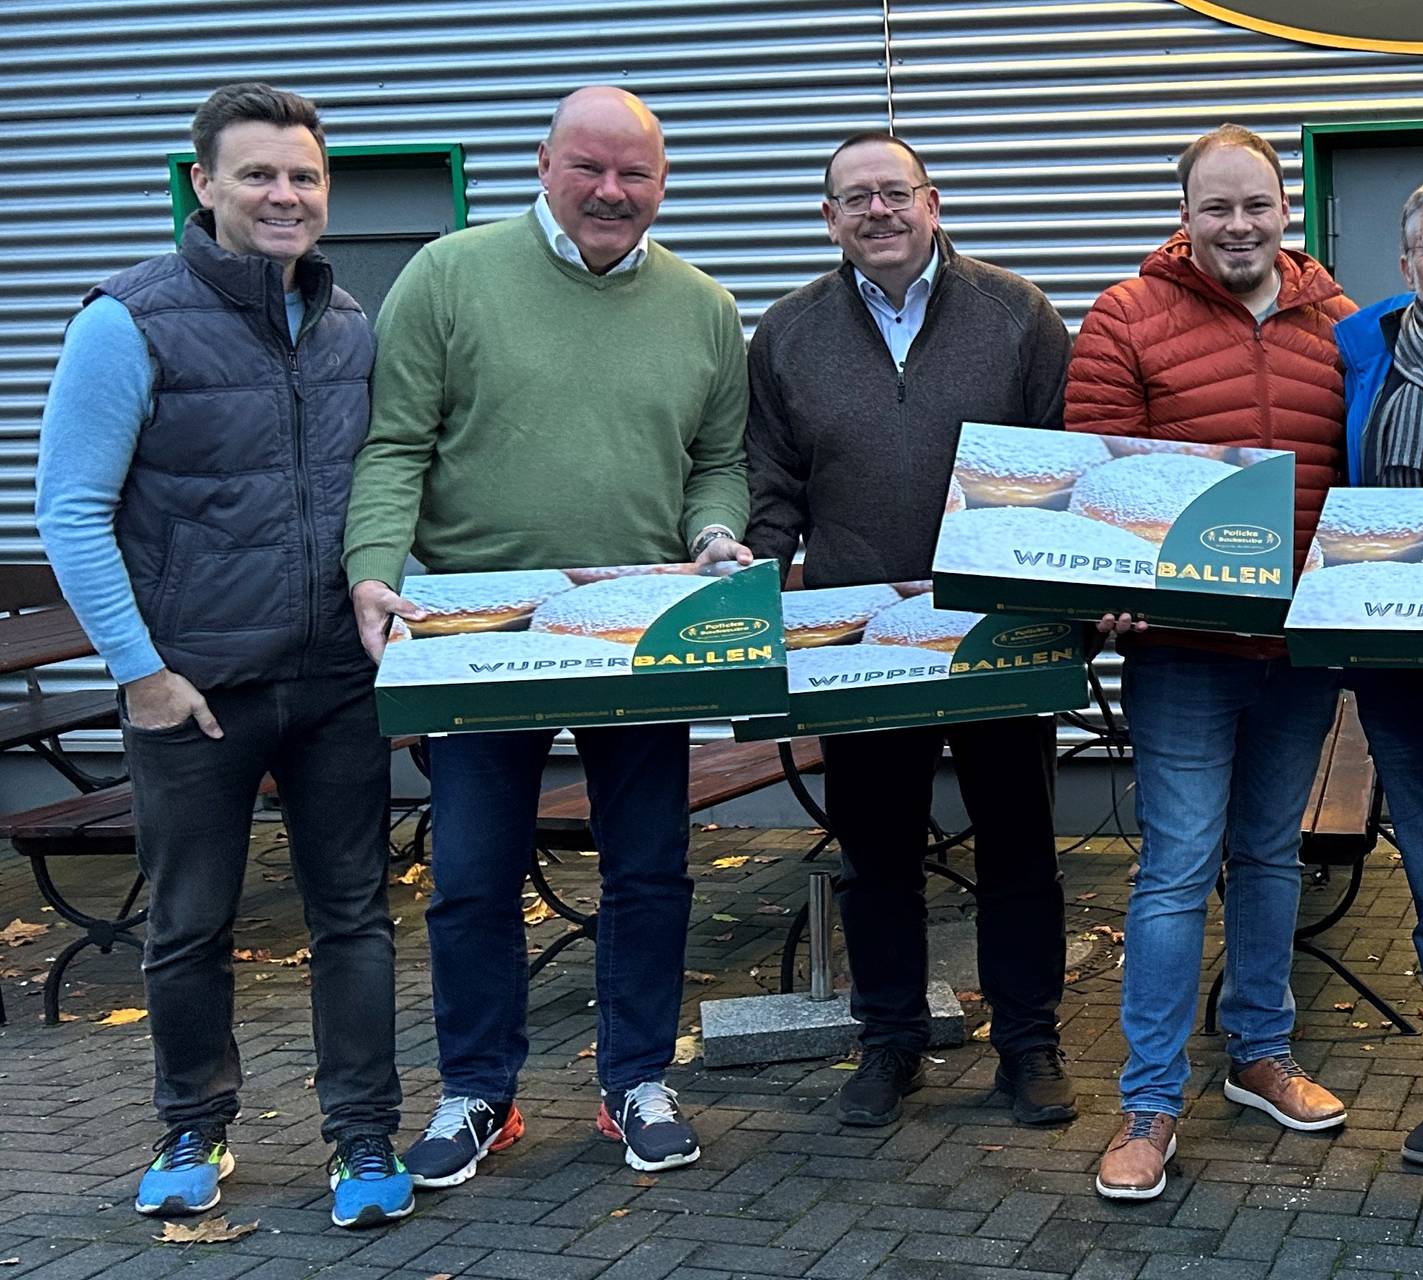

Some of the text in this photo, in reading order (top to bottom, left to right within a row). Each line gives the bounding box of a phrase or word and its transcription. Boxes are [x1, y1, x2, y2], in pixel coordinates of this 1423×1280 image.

[1013, 549, 1281, 586] WUPPERBALLEN
[469, 645, 773, 674] WUPPERBALLEN
[808, 647, 1073, 688] WUPPERBALLEN
